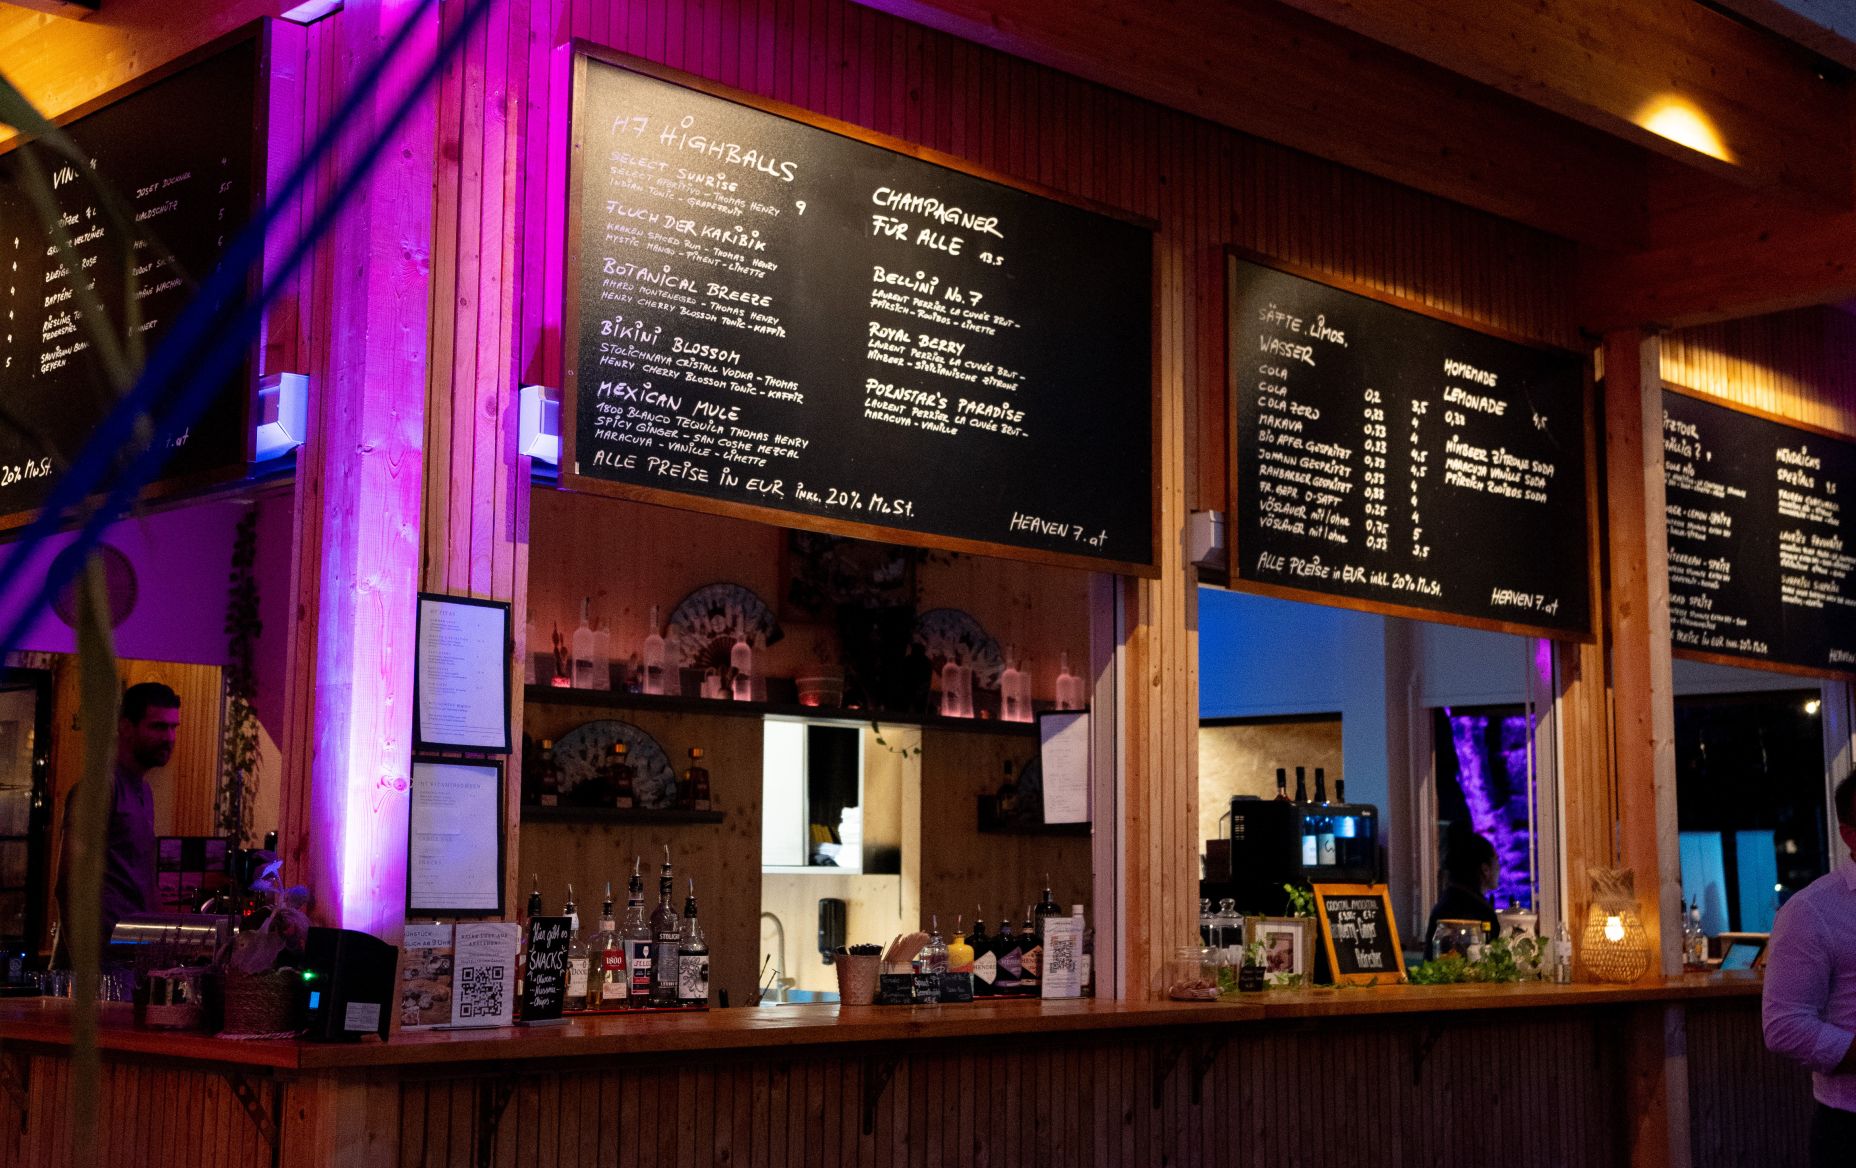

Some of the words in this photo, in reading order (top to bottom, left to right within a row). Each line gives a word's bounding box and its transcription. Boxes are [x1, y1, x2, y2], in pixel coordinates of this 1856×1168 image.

[611, 116, 649, 135] H7
[660, 116, 797, 181] HIGHBALLS
[609, 153, 668, 171] SELECT
[677, 168, 738, 191] SUNRISE
[610, 167, 653, 180] SELECT
[750, 202, 780, 216] HENRY
[795, 200, 807, 215] 9
[650, 187, 674, 200] TONIC
[872, 187, 1004, 239] CHAMPAGNER
[607, 201, 659, 223] FLUCH
[665, 216, 696, 236] DER
[701, 225, 766, 252] KARIBIK
[916, 229, 965, 256] ALLE
[606, 233, 639, 247] MYSTIC
[647, 242, 674, 255] MANGO
[686, 250, 721, 267] PIMENT
[729, 263, 766, 278] LIMETTE
[684, 239, 701, 251] RUM
[713, 247, 745, 262] THOMAS
[753, 259, 778, 271] HENRY
[603, 257, 698, 293] BOTANICAL
[706, 283, 773, 307] BREEZE
[873, 266, 939, 295] BELLINI
[969, 291, 983, 306] 7
[601, 291, 633, 303] HENRY
[637, 299, 676, 312] CHERRY
[680, 306, 717, 321] BLOSSOM
[722, 316, 745, 328] TONIC
[753, 324, 786, 338] KAFFIR
[639, 286, 697, 305] MONTENEGRO
[710, 302, 745, 317] THOMAS
[751, 312, 780, 325] HENRY
[872, 289, 910, 303] LAURENT
[913, 297, 946, 313] PERRIER
[950, 307, 961, 316] LA
[993, 315, 1014, 327] BRUT
[917, 309, 951, 325] ROOIBOS
[961, 320, 996, 335] LIMETTE
[600, 316, 661, 344] BIKINI
[672, 337, 740, 365] BLOSSOM
[868, 339, 906, 354] LAURENT
[911, 349, 945, 365] PERRIER
[949, 358, 961, 367] LA
[997, 366, 1018, 379] BRUT
[869, 322, 911, 343] ROYAL
[918, 335, 966, 356] BERRY
[1260, 335, 1315, 366] WASSER
[600, 343, 672, 365] STOLICHNAYA
[676, 357, 718, 373] CRISTALL
[722, 367, 754, 381] VODKA
[765, 376, 799, 391] THOMAS
[600, 356, 634, 370] HENRY
[643, 365, 680, 379] CHERRY
[685, 372, 727, 388] BLOSSOM
[730, 383, 757, 396] TONIC
[768, 390, 804, 404] KAFFIR
[1444, 358, 1498, 387] HOMEMADE
[597, 381, 682, 411] MEXICAN
[692, 401, 741, 421] MULE
[865, 378, 948, 410] PORNSTAR'S
[958, 398, 1025, 422] PARADISE
[1258, 382, 1287, 397] COLA
[1411, 417, 1419, 429] 4
[1259, 365, 1287, 380] COLA
[1364, 389, 1381, 404] 0,2
[1411, 400, 1429, 415] 3,5
[1443, 386, 1507, 416] LEMONADE
[596, 402, 623, 415] 1800
[627, 407, 671, 424] BLANCO
[676, 416, 724, 434] TEQUILA
[730, 427, 769, 441] THOMAS
[775, 434, 809, 449] HENRY
[864, 397, 906, 414] LAURENT
[912, 408, 949, 423] PERRIER
[954, 416, 966, 425] LA
[1001, 424, 1022, 436] BRUT
[864, 409, 911, 427] MARACUYA
[921, 421, 958, 435] VANILLE
[1257, 397, 1286, 412] COLA
[1290, 402, 1320, 420] ZERO
[1410, 432, 1418, 445] 4
[594, 416, 632, 430] SPICY
[636, 422, 678, 438] GINGER
[693, 434, 715, 444] SAN
[758, 446, 799, 459] MEZCAL
[594, 429, 652, 447] MARACUYA
[669, 442, 711, 457] VANILLE
[723, 450, 767, 467] LIMETTE
[1259, 414, 1303, 432] MAKAVA
[1411, 449, 1428, 463] 4,5
[1276, 434, 1303, 449] APFEL
[1410, 464, 1428, 477] 4,5
[1445, 434, 1489, 463] HIMBEER
[1532, 461, 1555, 478] SODA
[1, 465, 22, 487] 20%
[593, 450, 637, 468] ALLE
[647, 457, 709, 483] PREISE
[746, 479, 784, 497] EUR
[826, 488, 862, 510] 20%
[1410, 480, 1418, 492] 4
[1524, 475, 1546, 489] SODA
[1364, 503, 1387, 516] 0,25
[1411, 511, 1419, 524] 4
[1410, 495, 1418, 507] 4
[1524, 491, 1547, 504] SODA
[1259, 513, 1304, 535] VÖSLAUER
[1366, 535, 1387, 550] 0,33
[1412, 544, 1430, 558] 3,5
[1260, 496, 1307, 519] VÖSLAUER
[1365, 519, 1389, 534] 0,75
[1413, 528, 1422, 540] 5
[1257, 551, 1285, 571] ALLE
[1289, 555, 1330, 579] PREISE
[1342, 564, 1367, 584] EUR
[1391, 573, 1415, 591] 20%
[529, 950, 563, 970] SNACKS
[606, 956, 622, 965] 1800
